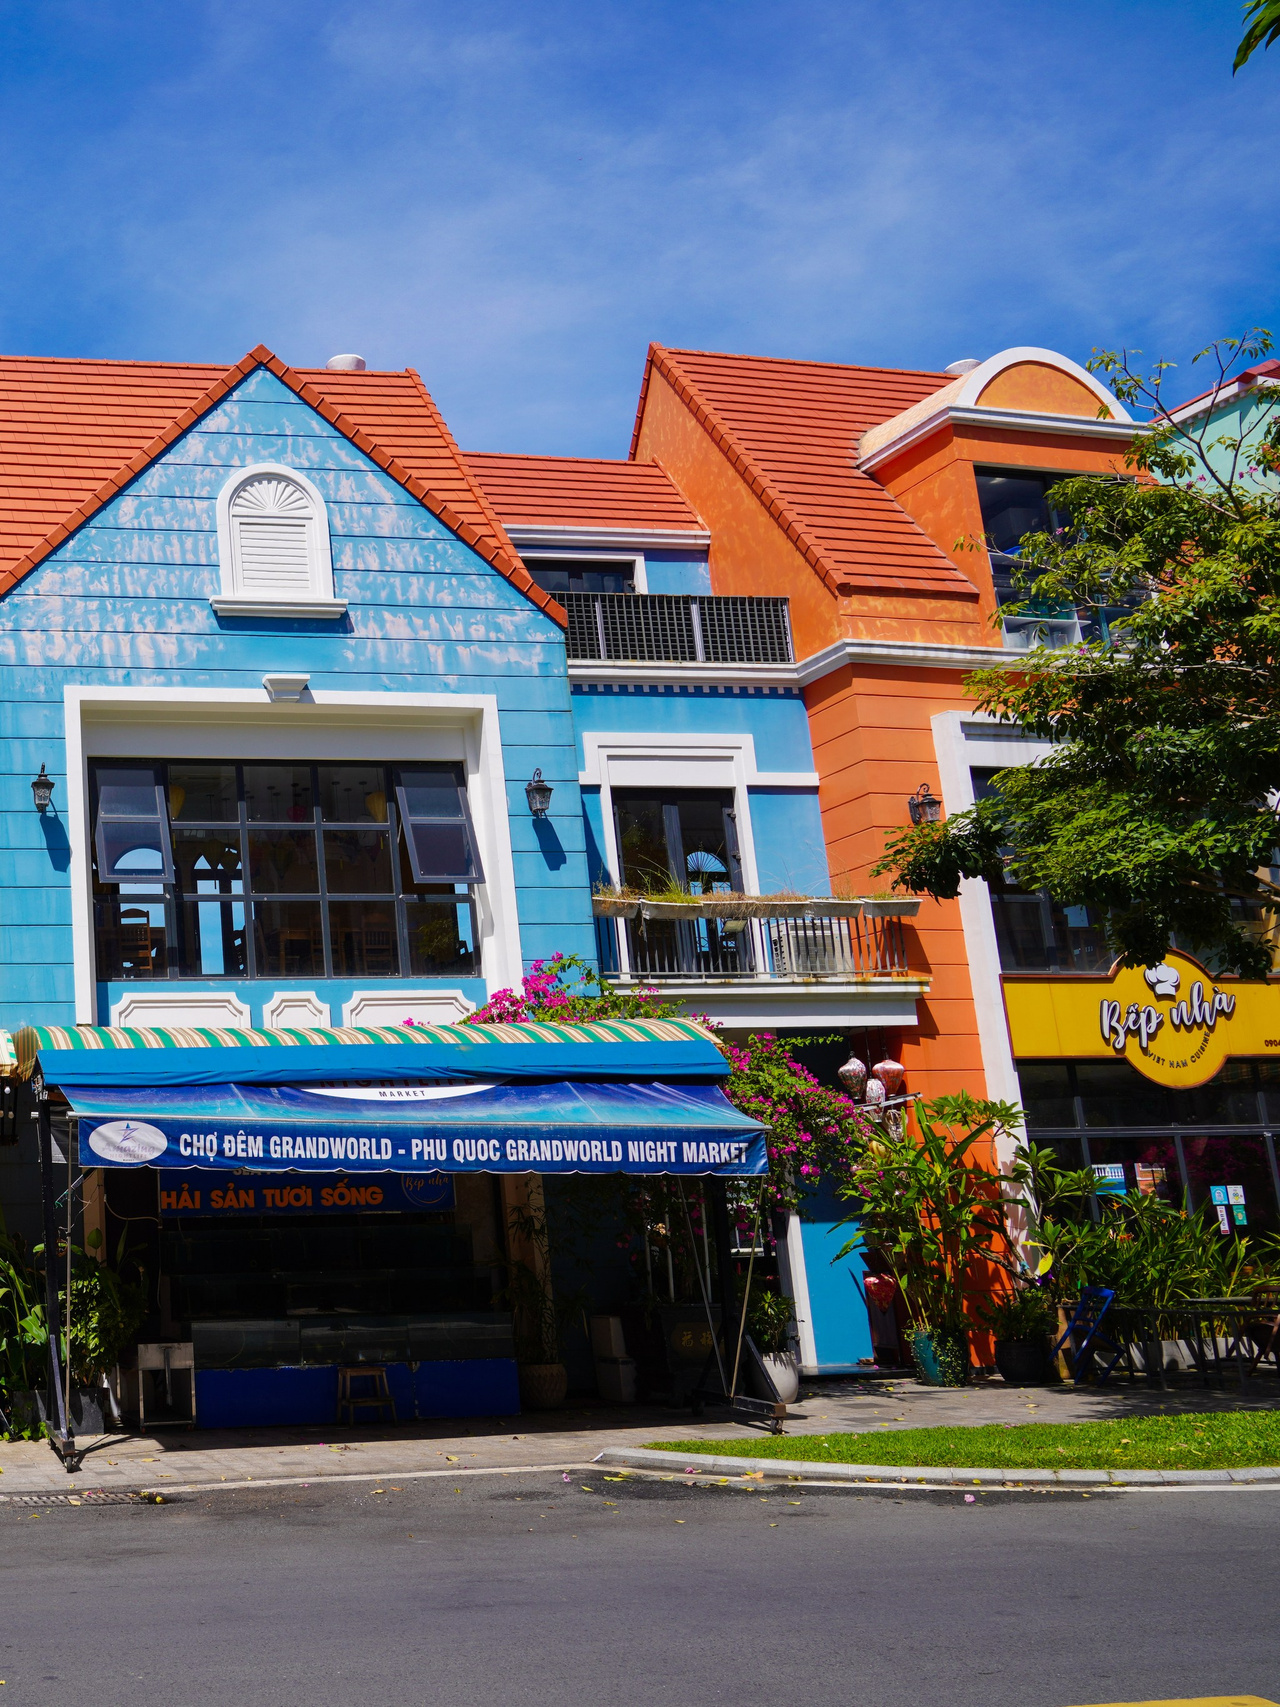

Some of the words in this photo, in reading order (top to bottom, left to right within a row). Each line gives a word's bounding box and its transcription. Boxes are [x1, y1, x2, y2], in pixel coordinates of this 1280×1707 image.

[1100, 998, 1164, 1050] Bếp
[1169, 980, 1236, 1027] nhà
[1147, 1050, 1166, 1066] VIET
[1168, 1059, 1189, 1069] NAM
[1190, 1030, 1211, 1063] CUISINE
[378, 1089, 426, 1098] MARKET
[179, 1131, 218, 1162] CHỢ
[222, 1129, 264, 1159] ĐÊM
[269, 1135, 393, 1161] GRANDWORLD
[411, 1138, 447, 1161] PHU
[452, 1138, 501, 1164] QUOC
[505, 1138, 622, 1163] GRANDWORLD
[628, 1140, 678, 1164] NIGHT
[683, 1141, 749, 1165] MARKET
[160, 1183, 201, 1210] HẢI
[210, 1182, 255, 1209] SẢN
[262, 1185, 313, 1208] TƯƠI
[320, 1178, 384, 1207] SỐNG
